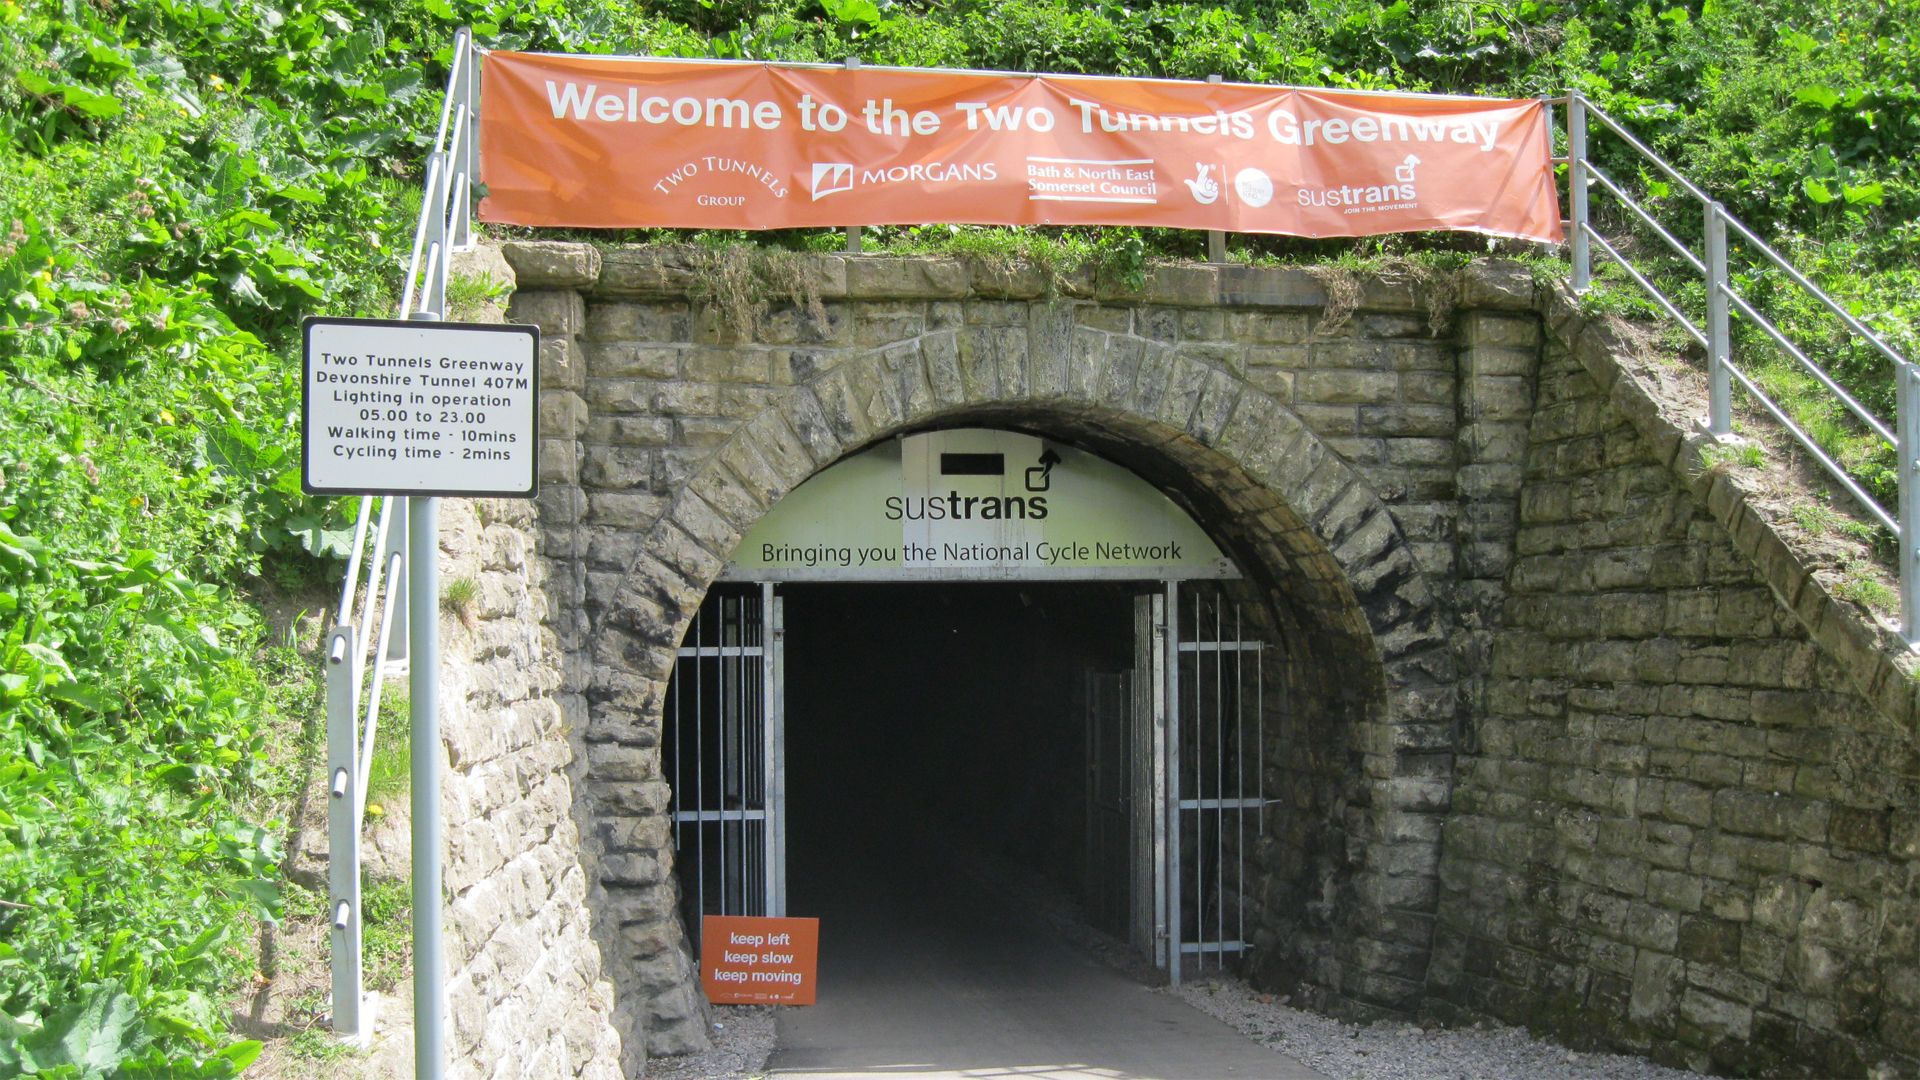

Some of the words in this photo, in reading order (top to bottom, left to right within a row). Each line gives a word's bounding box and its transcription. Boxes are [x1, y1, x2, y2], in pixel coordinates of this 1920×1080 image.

[545, 81, 781, 130] Welcome
[798, 94, 847, 132] to
[863, 99, 940, 136] the
[955, 102, 1054, 132] Two
[1069, 98, 1254, 139] Tunnels
[1268, 109, 1499, 151] Greenway
[653, 163, 697, 195] TWO
[702, 156, 789, 198] TUNNELS
[861, 162, 997, 184] MORGANS
[1027, 165, 1060, 178] Bath
[1063, 167, 1075, 179] &
[1079, 167, 1121, 180] North
[1126, 169, 1155, 181] East
[1028, 179, 1096, 193] Somerset
[1100, 182, 1156, 195] Council
[1297, 184, 1416, 207] sustrans
[697, 194, 745, 206] GROUP
[1378, 203, 1418, 211] MOVEMENT
[321, 353, 357, 366] Two
[366, 355, 432, 369] Tunnels
[439, 358, 524, 374] Greenway
[316, 371, 411, 386] Devonshire
[420, 375, 475, 388] Tunnel
[483, 377, 528, 389] 407M
[334, 390, 402, 406] Lighting
[410, 392, 424, 404] in
[432, 394, 511, 408] operation
[359, 409, 408, 421] 05.00
[416, 411, 432, 422] to
[440, 412, 486, 424] 23.00
[328, 426, 396, 442] Walking
[404, 428, 441, 440] time
[461, 430, 516, 443] 10mins
[333, 445, 397, 460] Cycling
[405, 446, 442, 458] time
[463, 448, 511, 460] 2mins
[885, 490, 1048, 520] sustrans
[762, 543, 851, 567] Bringing
[858, 546, 897, 567] you
[902, 543, 936, 562] the
[944, 541, 1030, 561] National
[1036, 541, 1089, 565] Cycle
[1095, 541, 1182, 560] Network
[730, 932, 763, 948] keep
[768, 933, 790, 945] left
[724, 950, 757, 966] keep
[762, 951, 794, 963] slow
[714, 968, 747, 984] keep
[752, 970, 802, 985] moving
